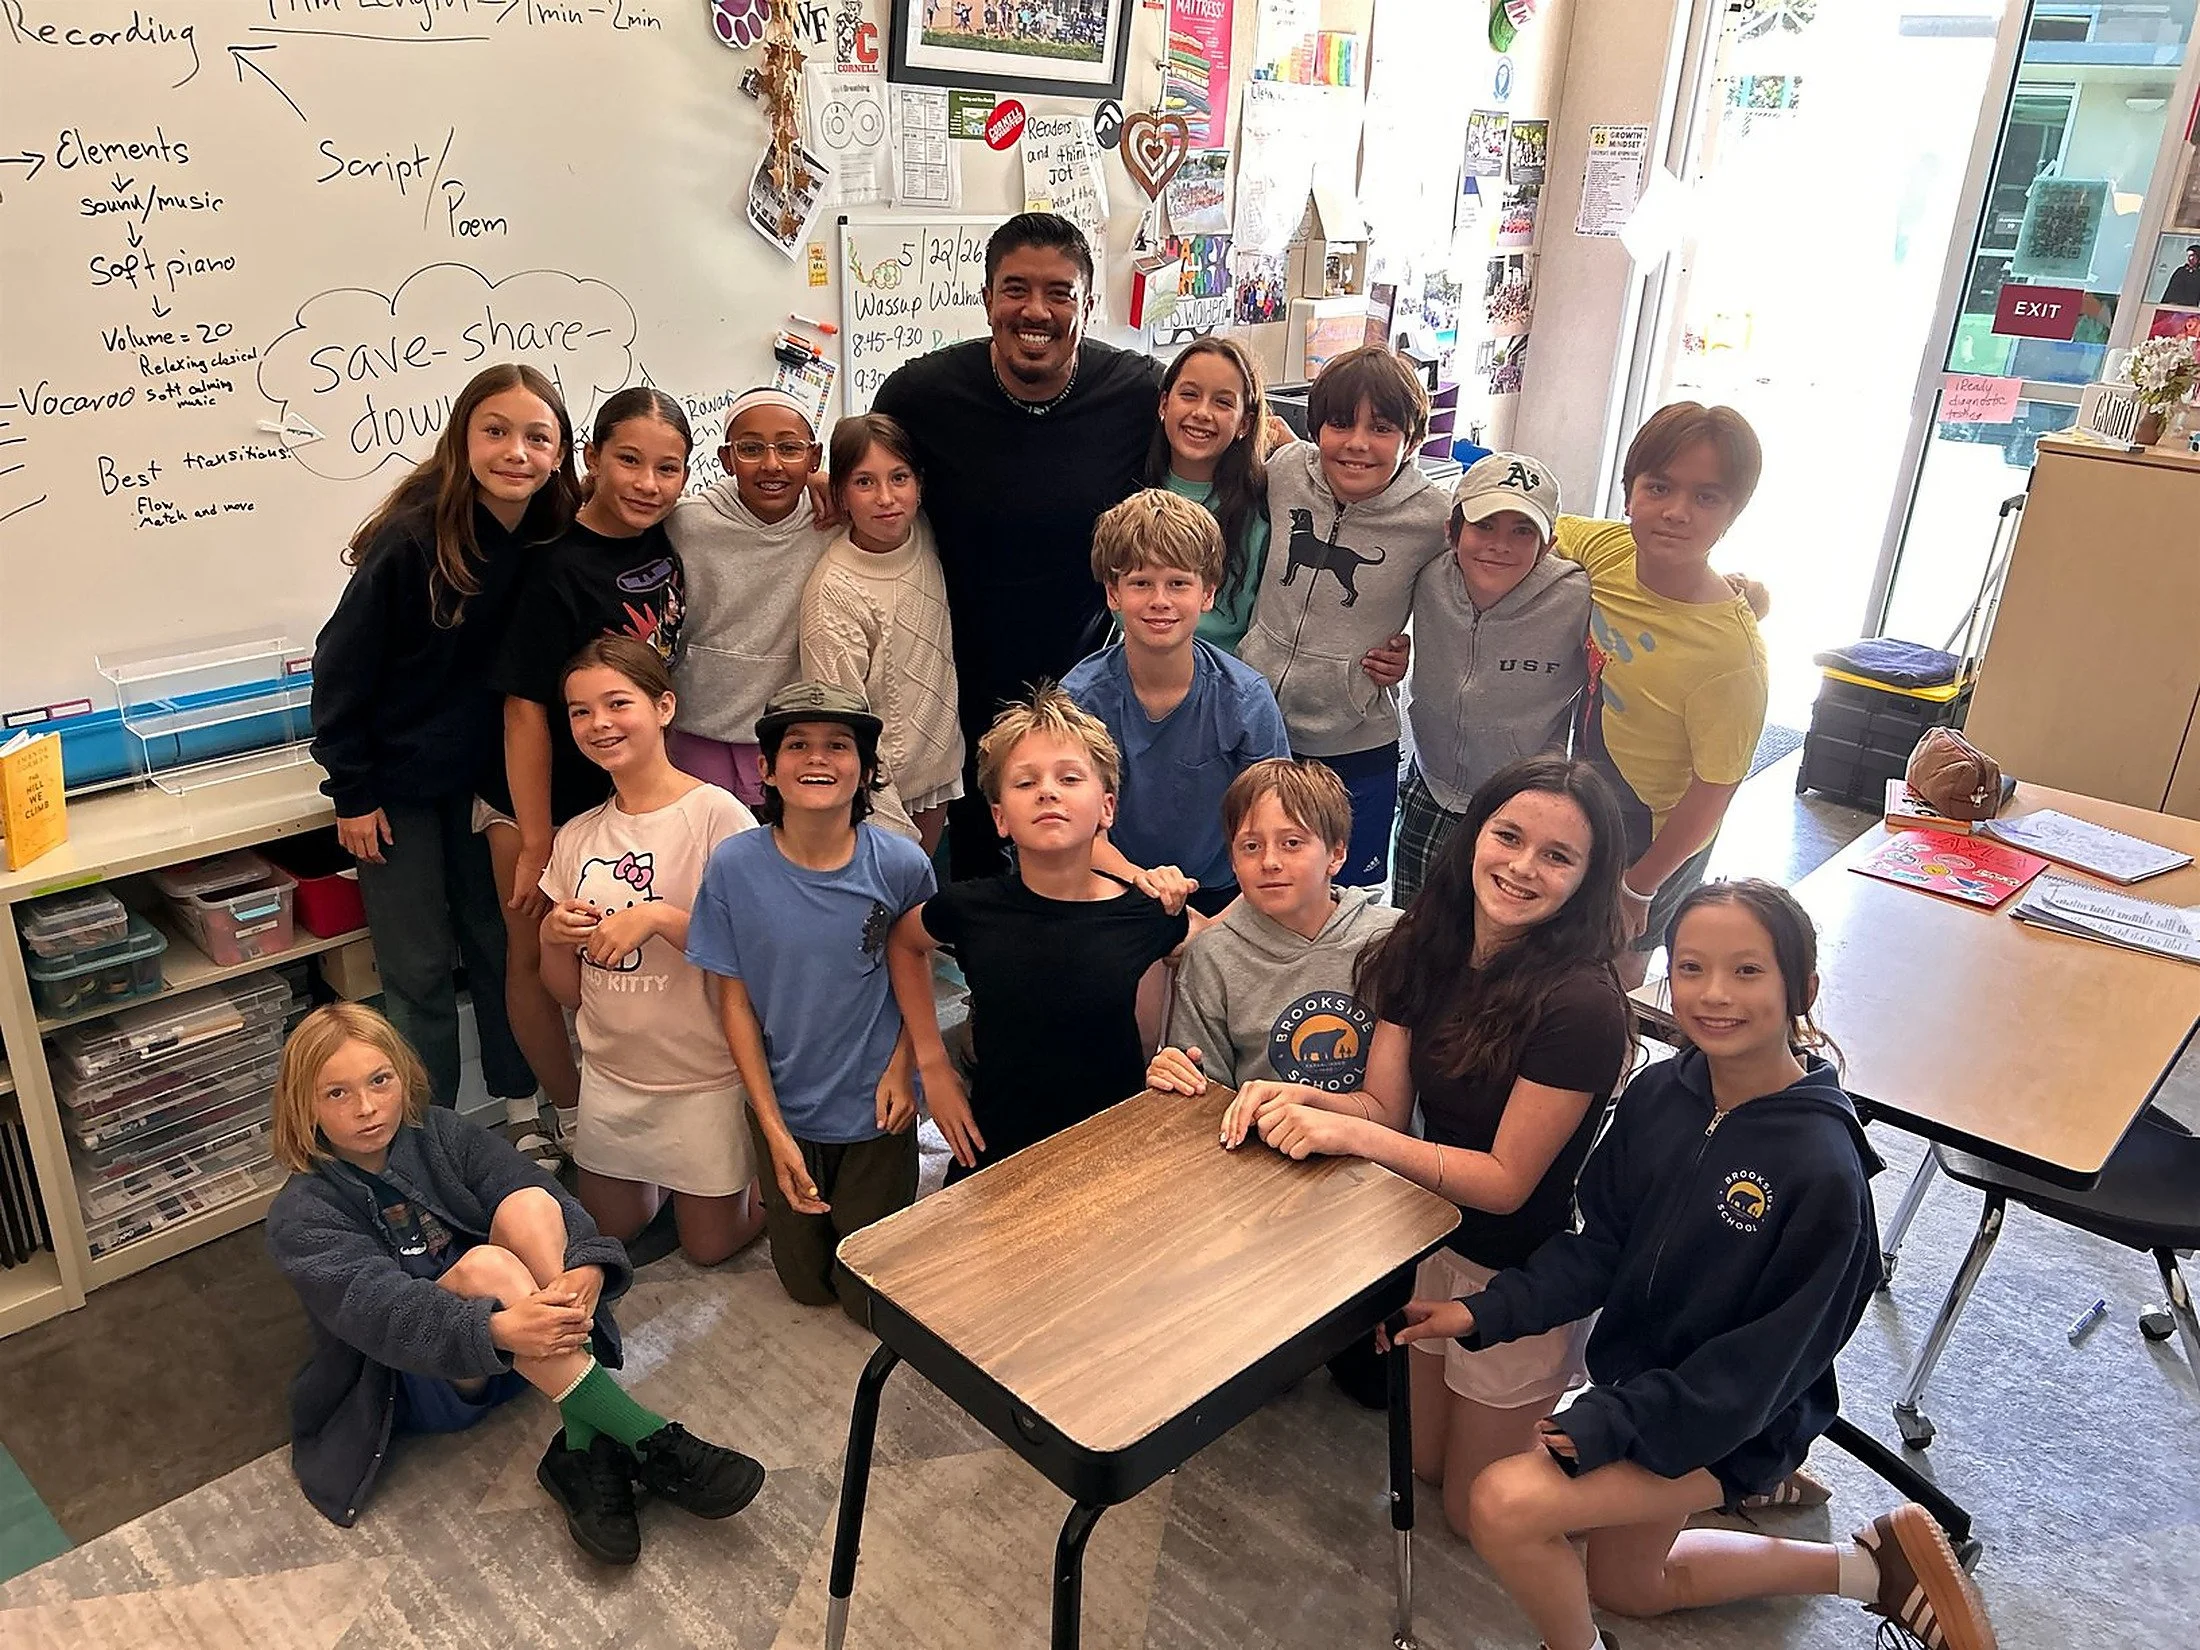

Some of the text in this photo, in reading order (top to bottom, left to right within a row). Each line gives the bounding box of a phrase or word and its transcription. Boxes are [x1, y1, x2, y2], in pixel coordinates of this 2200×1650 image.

[1, 0, 199, 88] Recording
[837, 64, 878, 73] CORNELL
[57, 126, 189, 169] Elements
[1608, 140, 1641, 149] MINDSET
[1609, 131, 1643, 140] GROWTH
[1027, 145, 1049, 163] and
[81, 185, 224, 224] sound/music
[442, 180, 507, 237] Poem
[90, 248, 236, 292] Soft piano
[855, 290, 922, 321] Wassup
[2014, 301, 2062, 318] EXIT
[102, 324, 176, 352] Volume
[196, 323, 233, 344] 20
[140, 353, 208, 378] Relaxing
[19, 381, 136, 416] Vocaroo
[177, 395, 216, 409] music
[99, 456, 162, 496] Best
[1498, 461, 1540, 491] A's
[137, 496, 174, 514] Flow
[194, 507, 218, 518] and
[223, 501, 254, 512] move
[27, 780, 44, 795] HILL
[29, 791, 43, 805] WE
[24, 801, 49, 819] CLIMB
[607, 974, 669, 992] KITTY
[1275, 997, 1374, 1043] BROOKSIDE
[1287, 1067, 1366, 1091] SCHOOL
[1724, 1169, 1773, 1212] BROOKSIDE
[1717, 1203, 1757, 1233] SCHOOL
